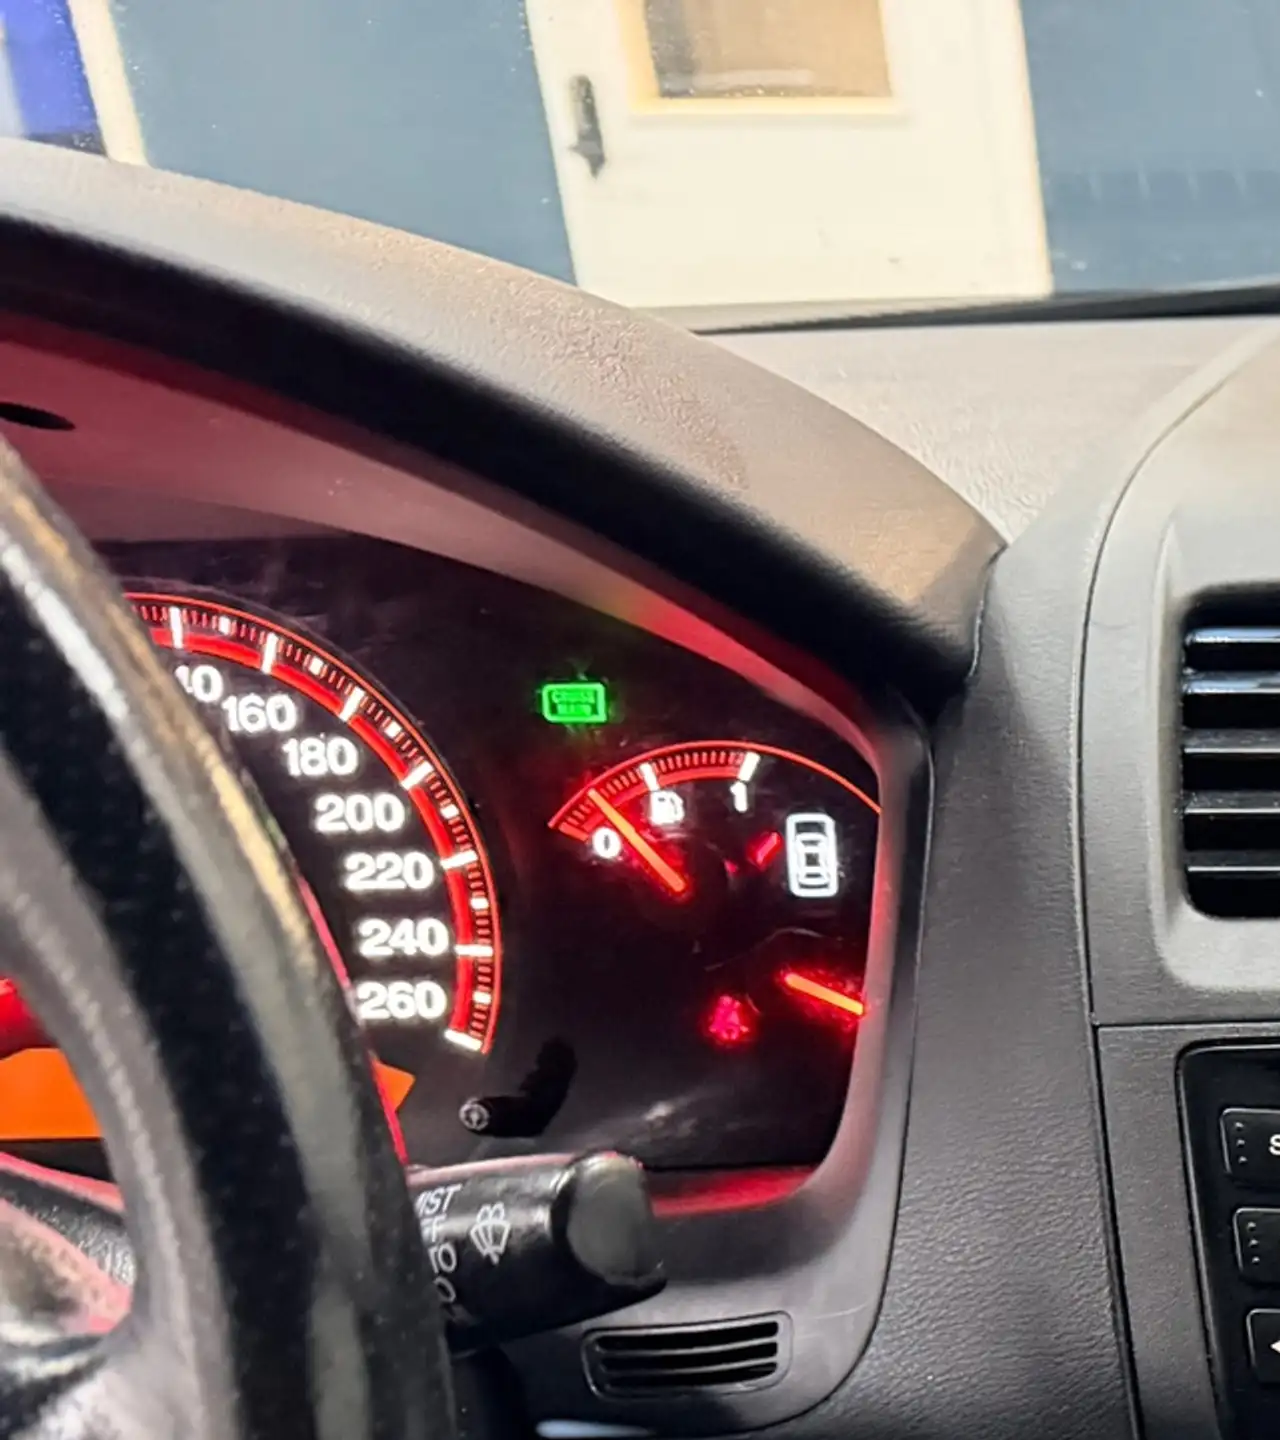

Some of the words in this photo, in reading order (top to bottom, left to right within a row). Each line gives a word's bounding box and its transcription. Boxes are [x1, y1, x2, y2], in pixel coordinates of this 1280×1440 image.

[221, 694, 297, 733] 160
[282, 737, 358, 776] 180
[315, 792, 405, 833] 200
[729, 780, 749, 813] 1
[592, 826, 621, 860] 0
[345, 852, 435, 890] 220
[359, 917, 450, 957] 240
[356, 980, 448, 1020] 260
